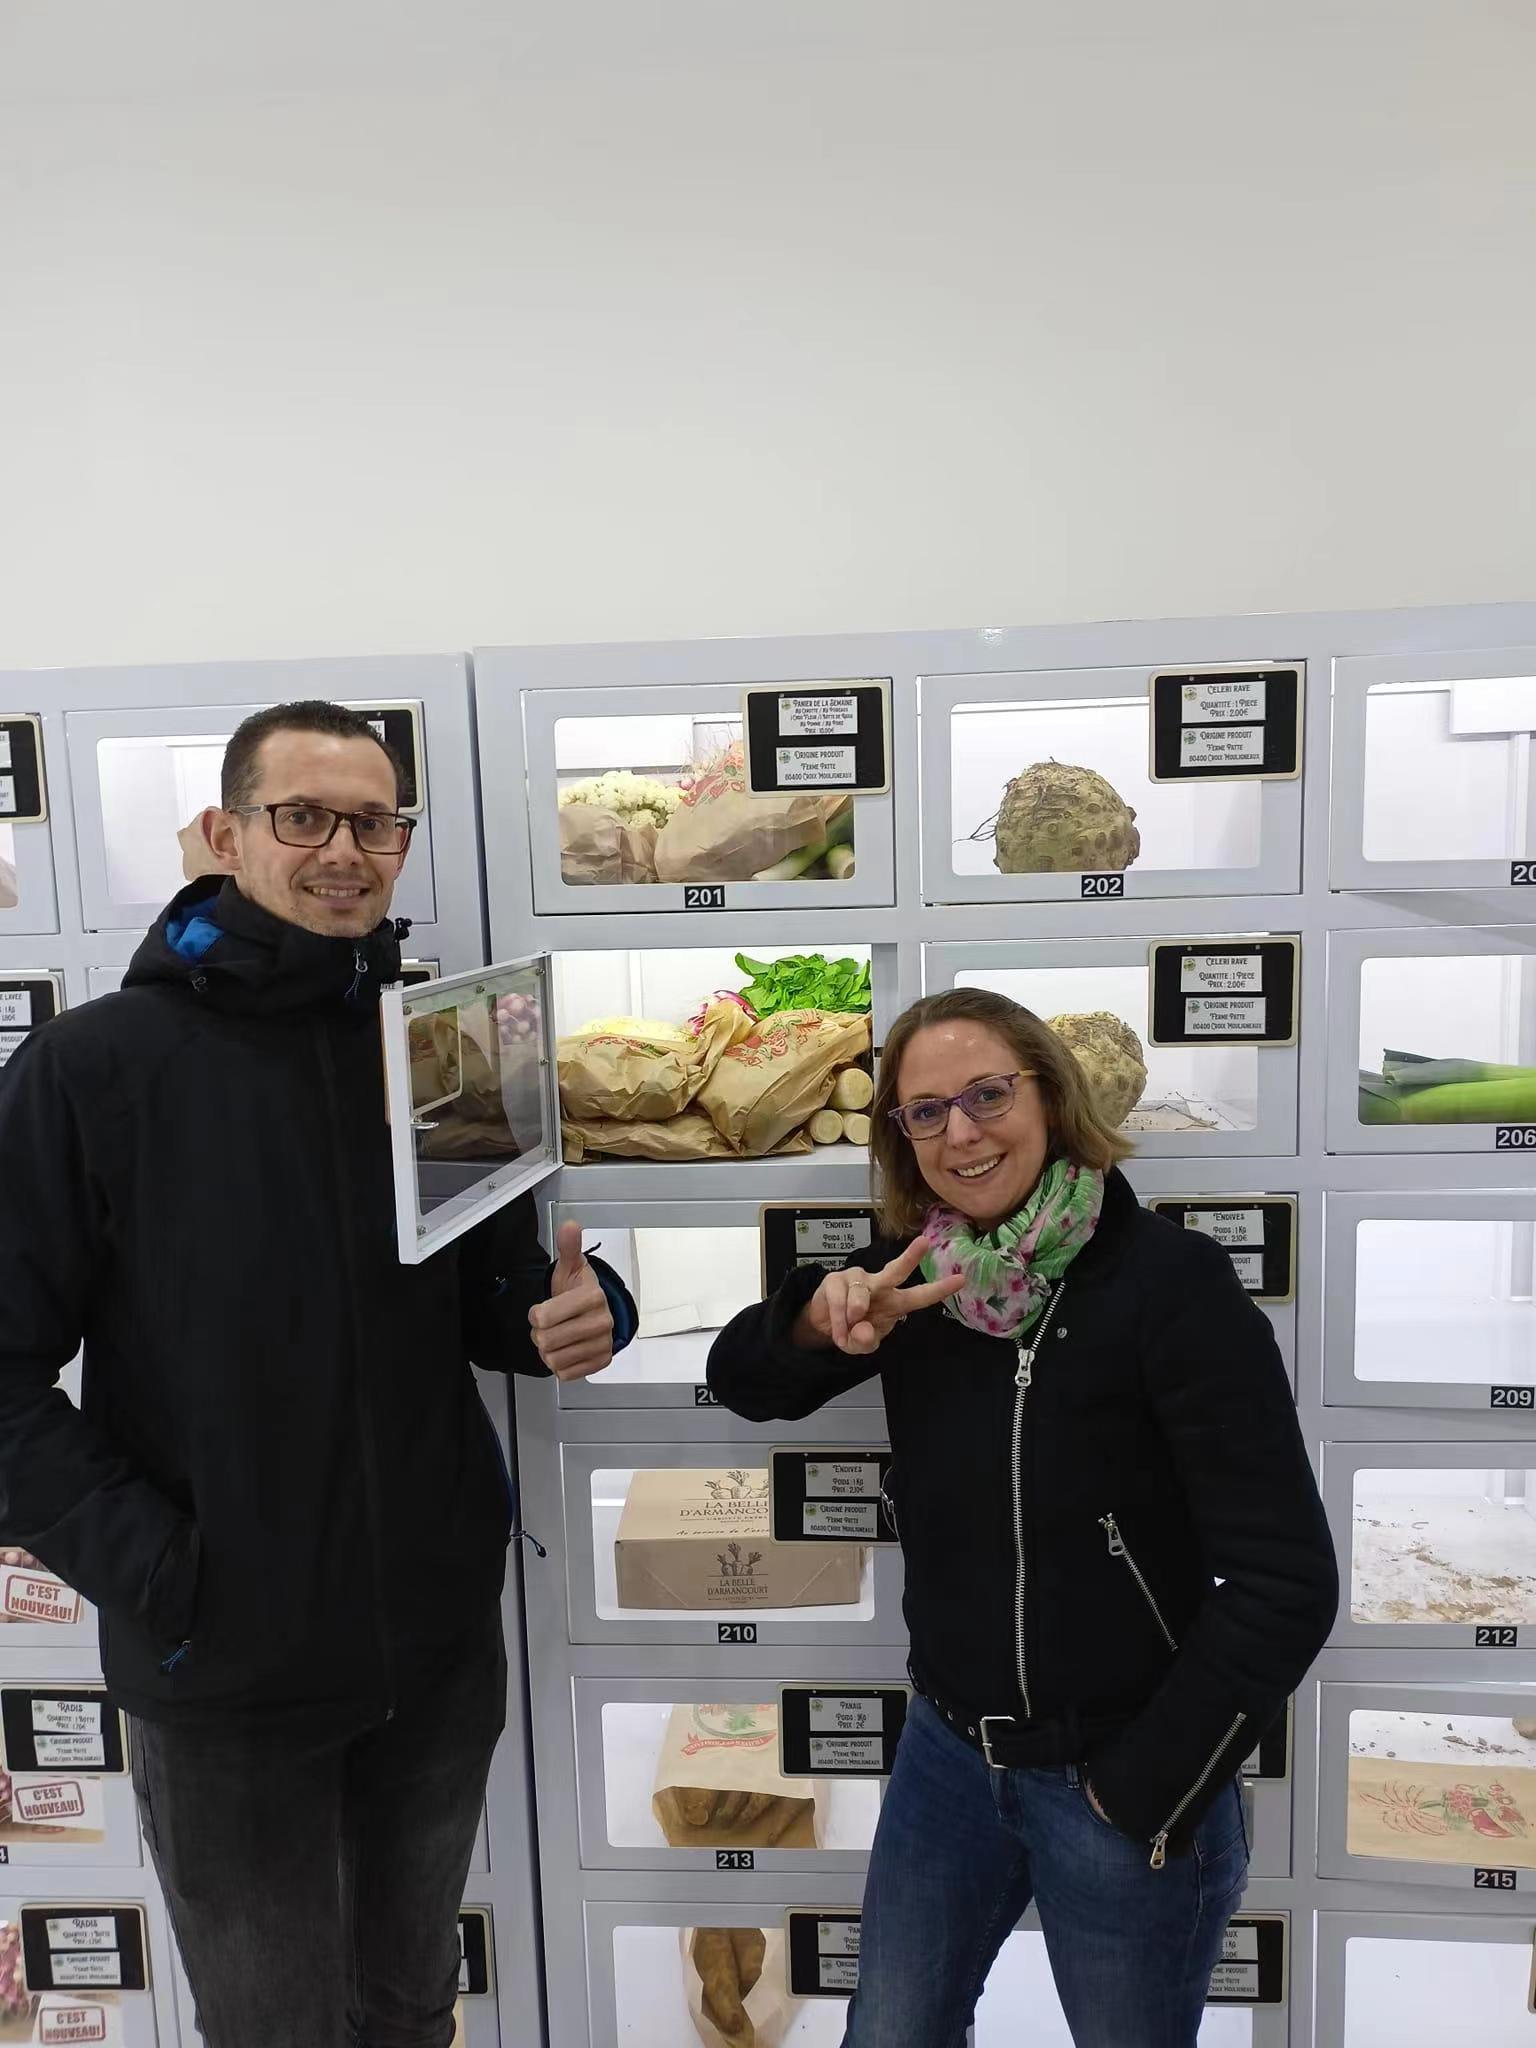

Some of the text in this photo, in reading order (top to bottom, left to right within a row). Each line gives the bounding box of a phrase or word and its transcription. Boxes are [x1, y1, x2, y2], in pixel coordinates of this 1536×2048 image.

[1227, 731, 1252, 739] PRODUIT
[1513, 865, 1536, 882] 20
[1084, 878, 1120, 895] 202
[688, 889, 721, 906] 201
[1498, 1130, 1536, 1146] 206
[1494, 1390, 1531, 1406] 209
[680, 1508, 768, 1516] D'ARMANCO
[26, 1584, 60, 1601] C'EST
[708, 1586, 768, 1595] D'ARMANCOURT
[12, 1597, 72, 1620] NOUVEAU!
[720, 1626, 754, 1640] 210
[1478, 1630, 1514, 1644] 212
[57, 1703, 83, 1712] RADIS
[33, 1787, 62, 1800] C'EST
[24, 1800, 79, 1816] NOUVEAU!
[719, 1854, 750, 1867] 213
[1476, 1872, 1513, 1887] 215
[72, 1919, 98, 1928] RADIS
[848, 1926, 860, 1934] PAN
[57, 2011, 86, 2024] C'EST
[45, 2025, 100, 2039] NOUVEAU!
